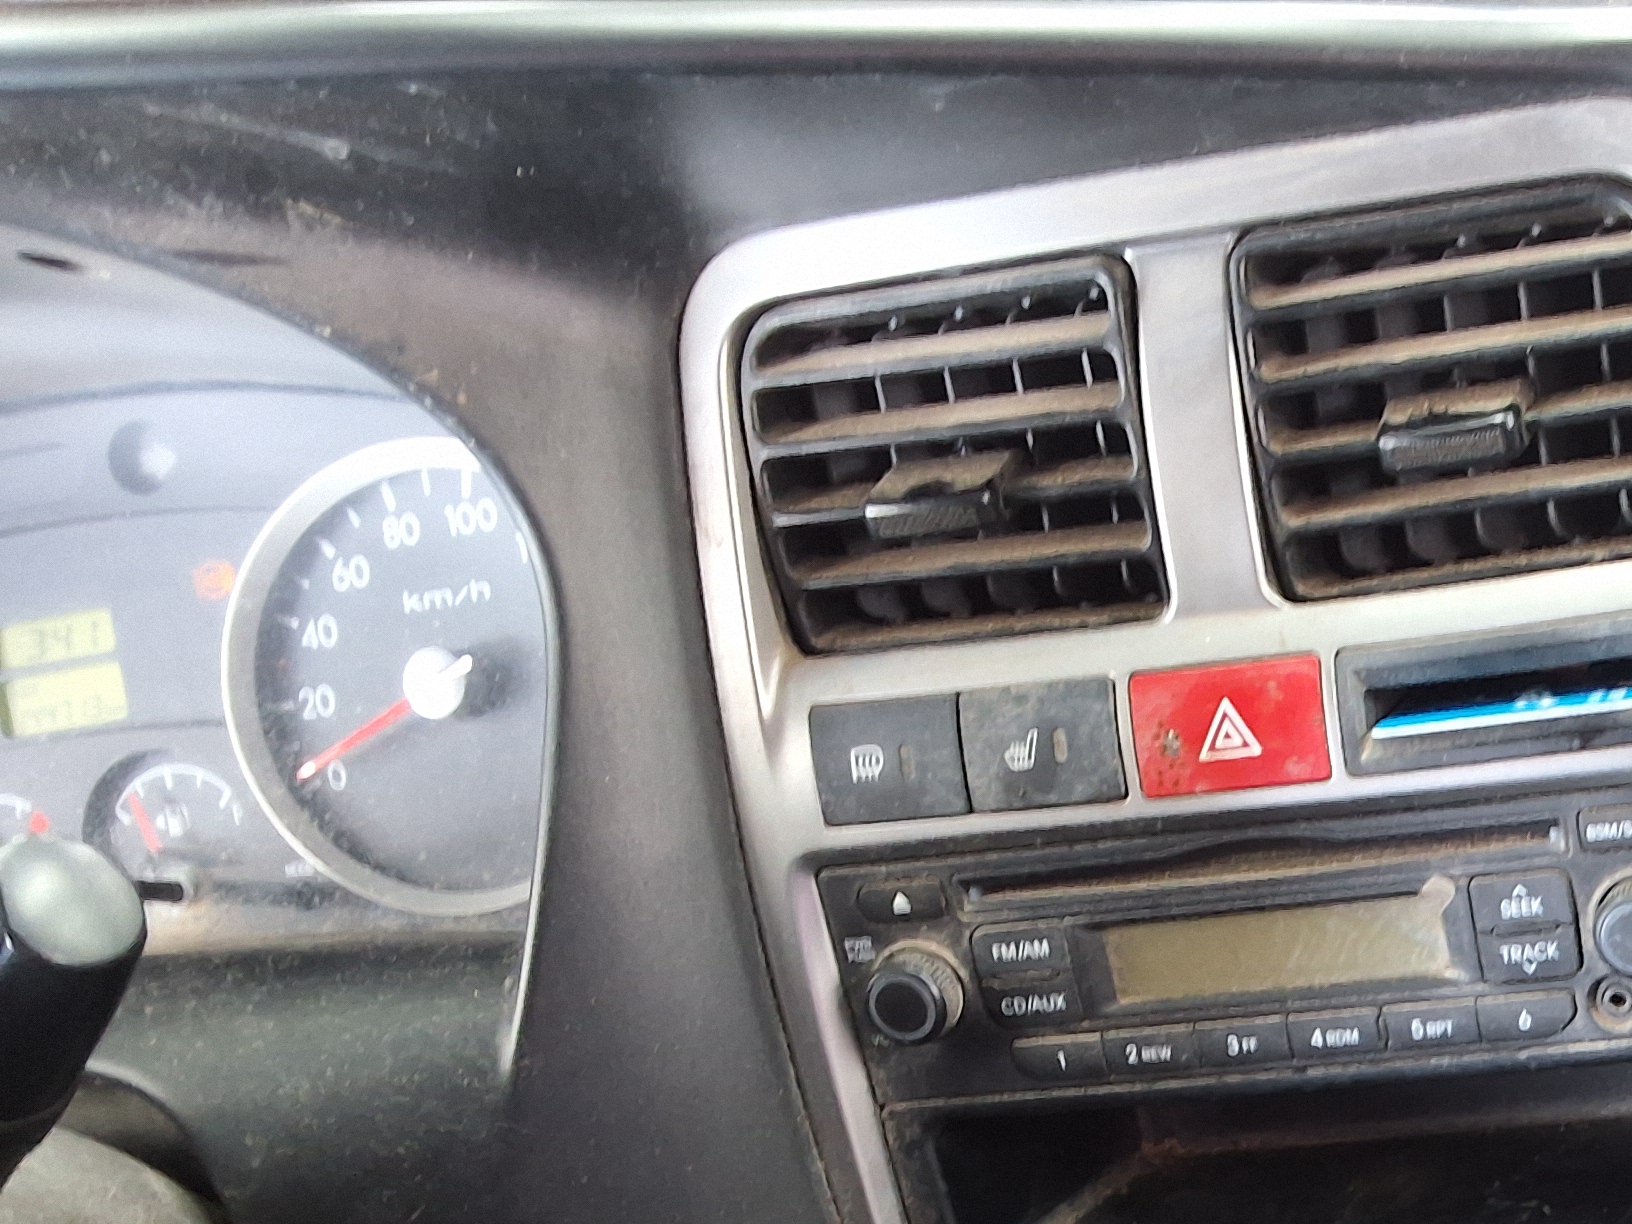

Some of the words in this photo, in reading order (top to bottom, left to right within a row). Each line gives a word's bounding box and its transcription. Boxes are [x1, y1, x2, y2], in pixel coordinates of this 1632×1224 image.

[382, 512, 420, 549] 80
[444, 499, 497, 536] 100
[332, 553, 370, 592] 60
[403, 578, 491, 614] km/h
[301, 614, 338, 649] 40
[299, 683, 336, 720] 20
[327, 758, 347, 791] 0
[1500, 894, 1543, 920] SEEK
[991, 937, 1050, 962] FM/AM
[1500, 939, 1560, 966] TRACK
[1001, 992, 1066, 1017] CD/AUX
[1125, 1043, 1139, 1065] 2
[1310, 1026, 1323, 1049] 4
